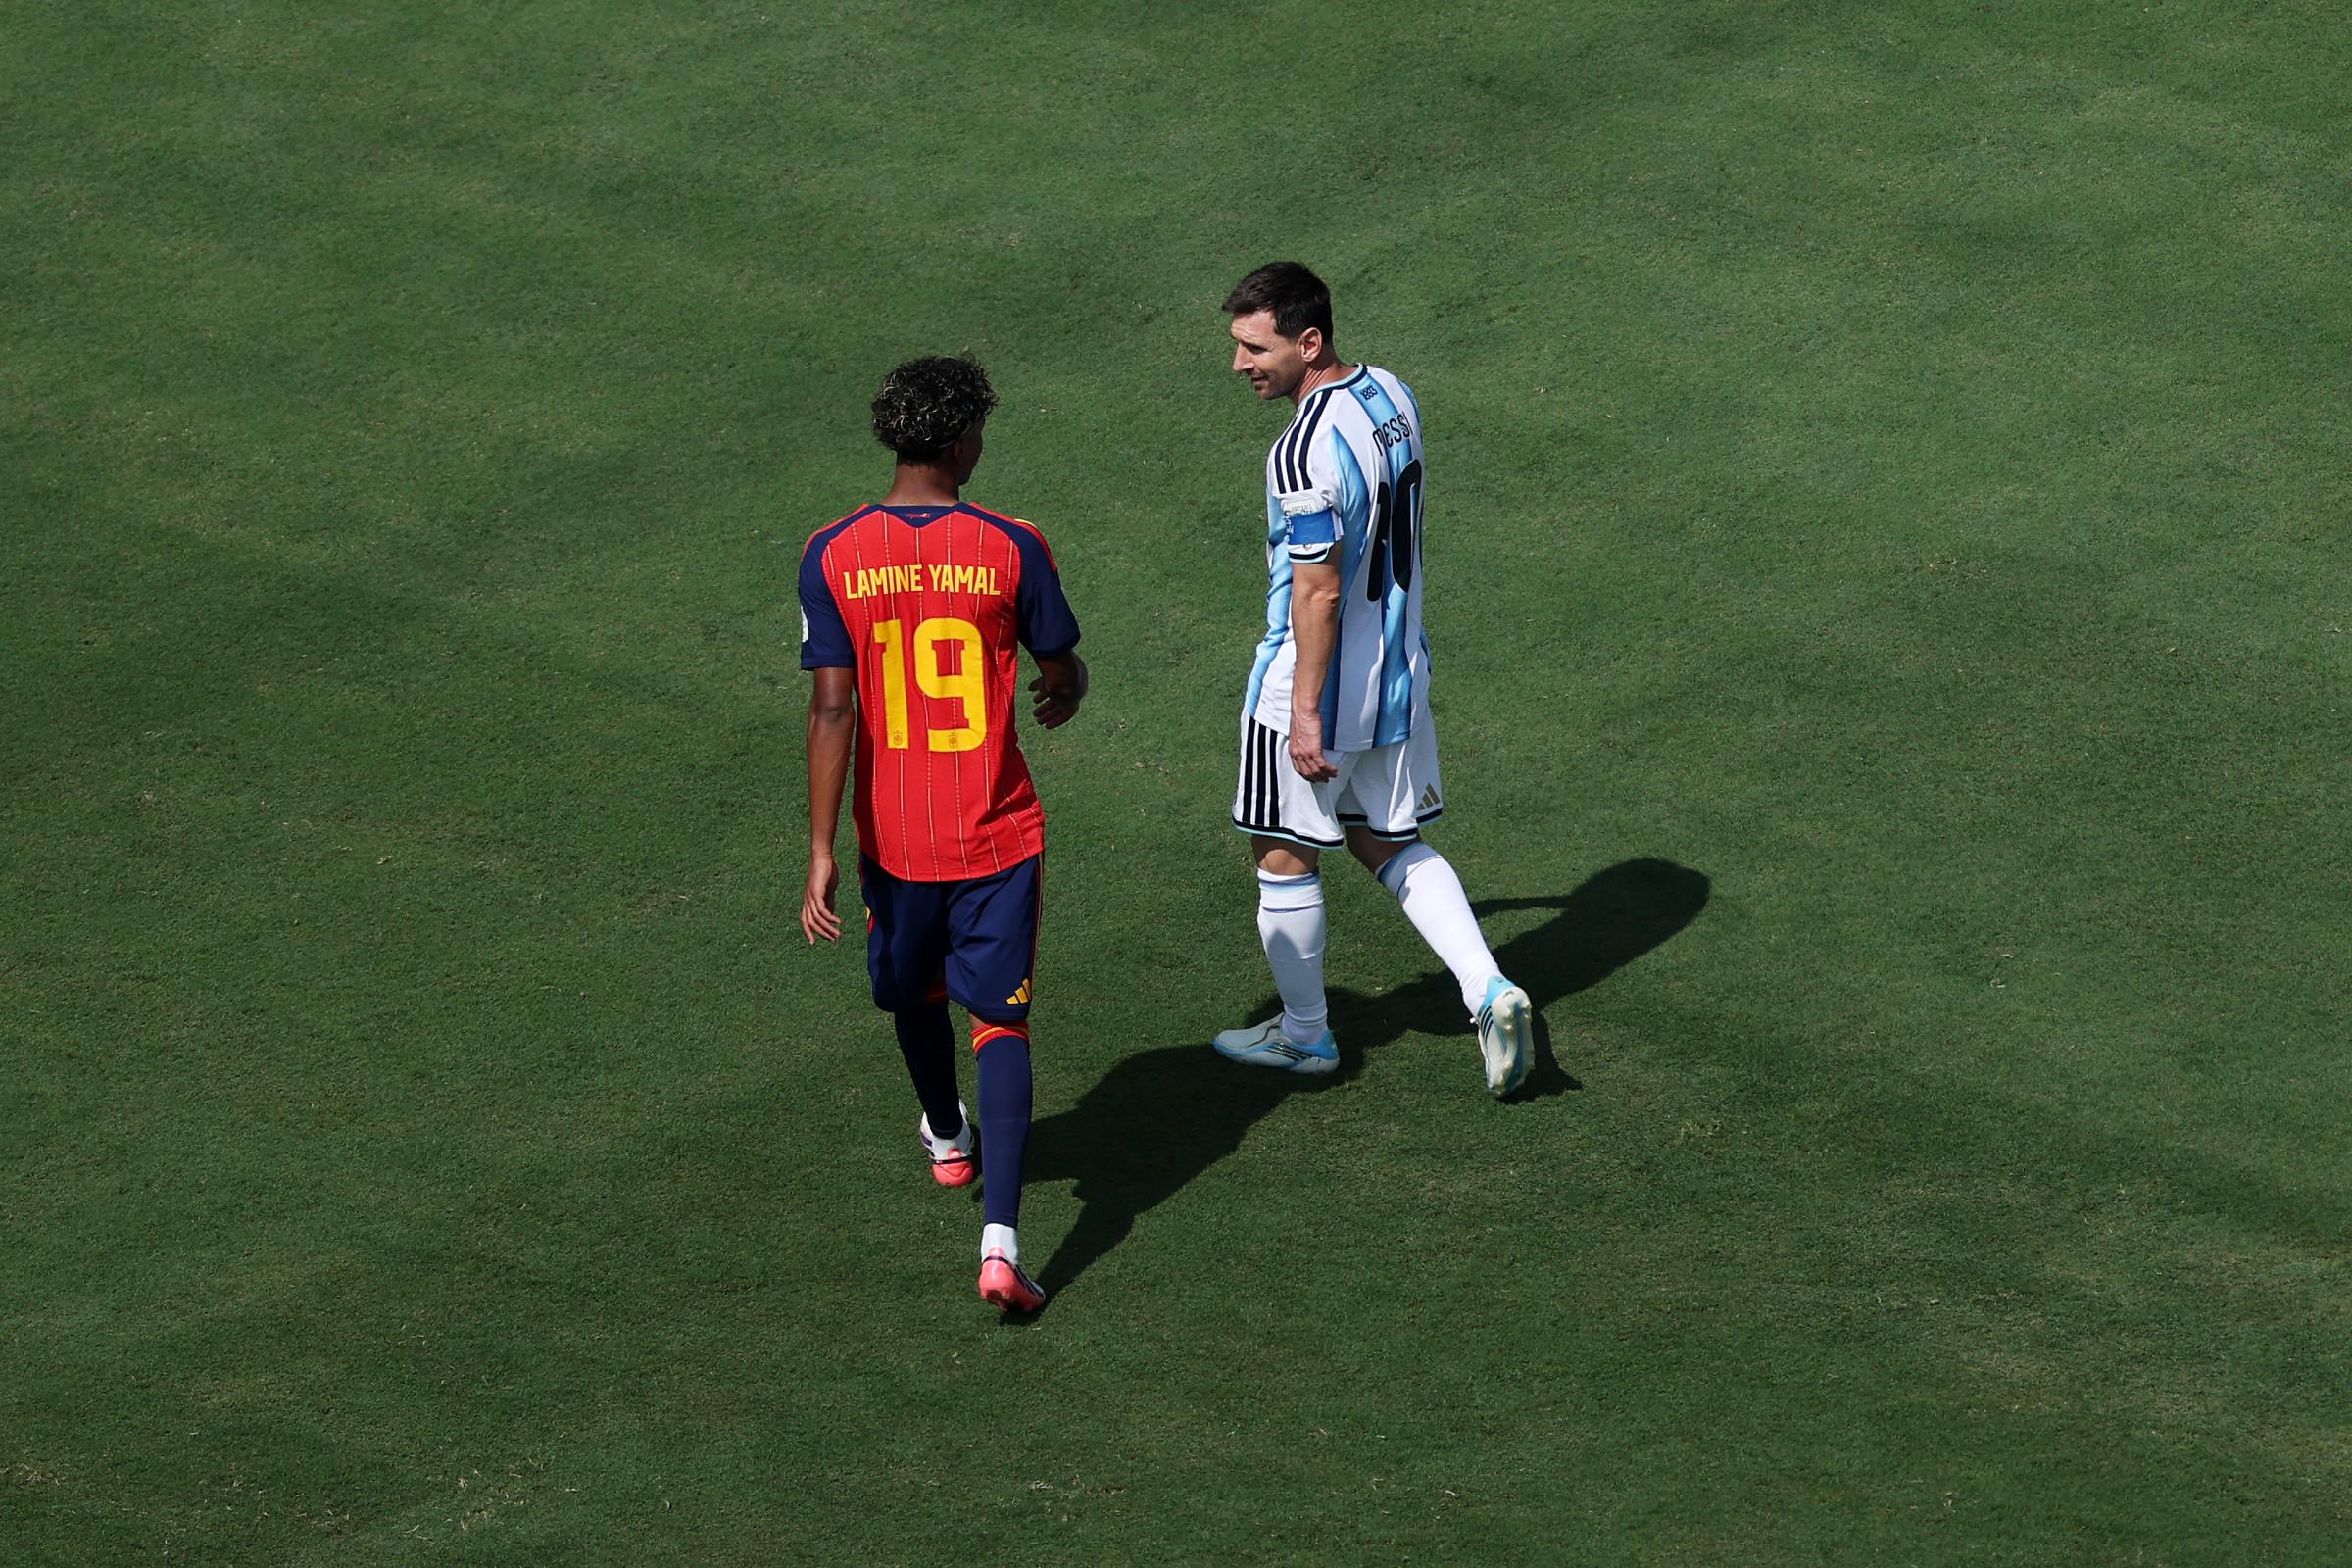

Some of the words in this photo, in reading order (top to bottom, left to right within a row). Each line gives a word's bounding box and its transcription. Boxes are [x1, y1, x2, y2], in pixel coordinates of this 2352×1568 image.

[1372, 412, 1413, 457] MESSI
[1366, 459, 1422, 602] 10
[844, 564, 923, 599] LAMINE
[928, 564, 1001, 596] YAMAL
[872, 617, 987, 752] 19
